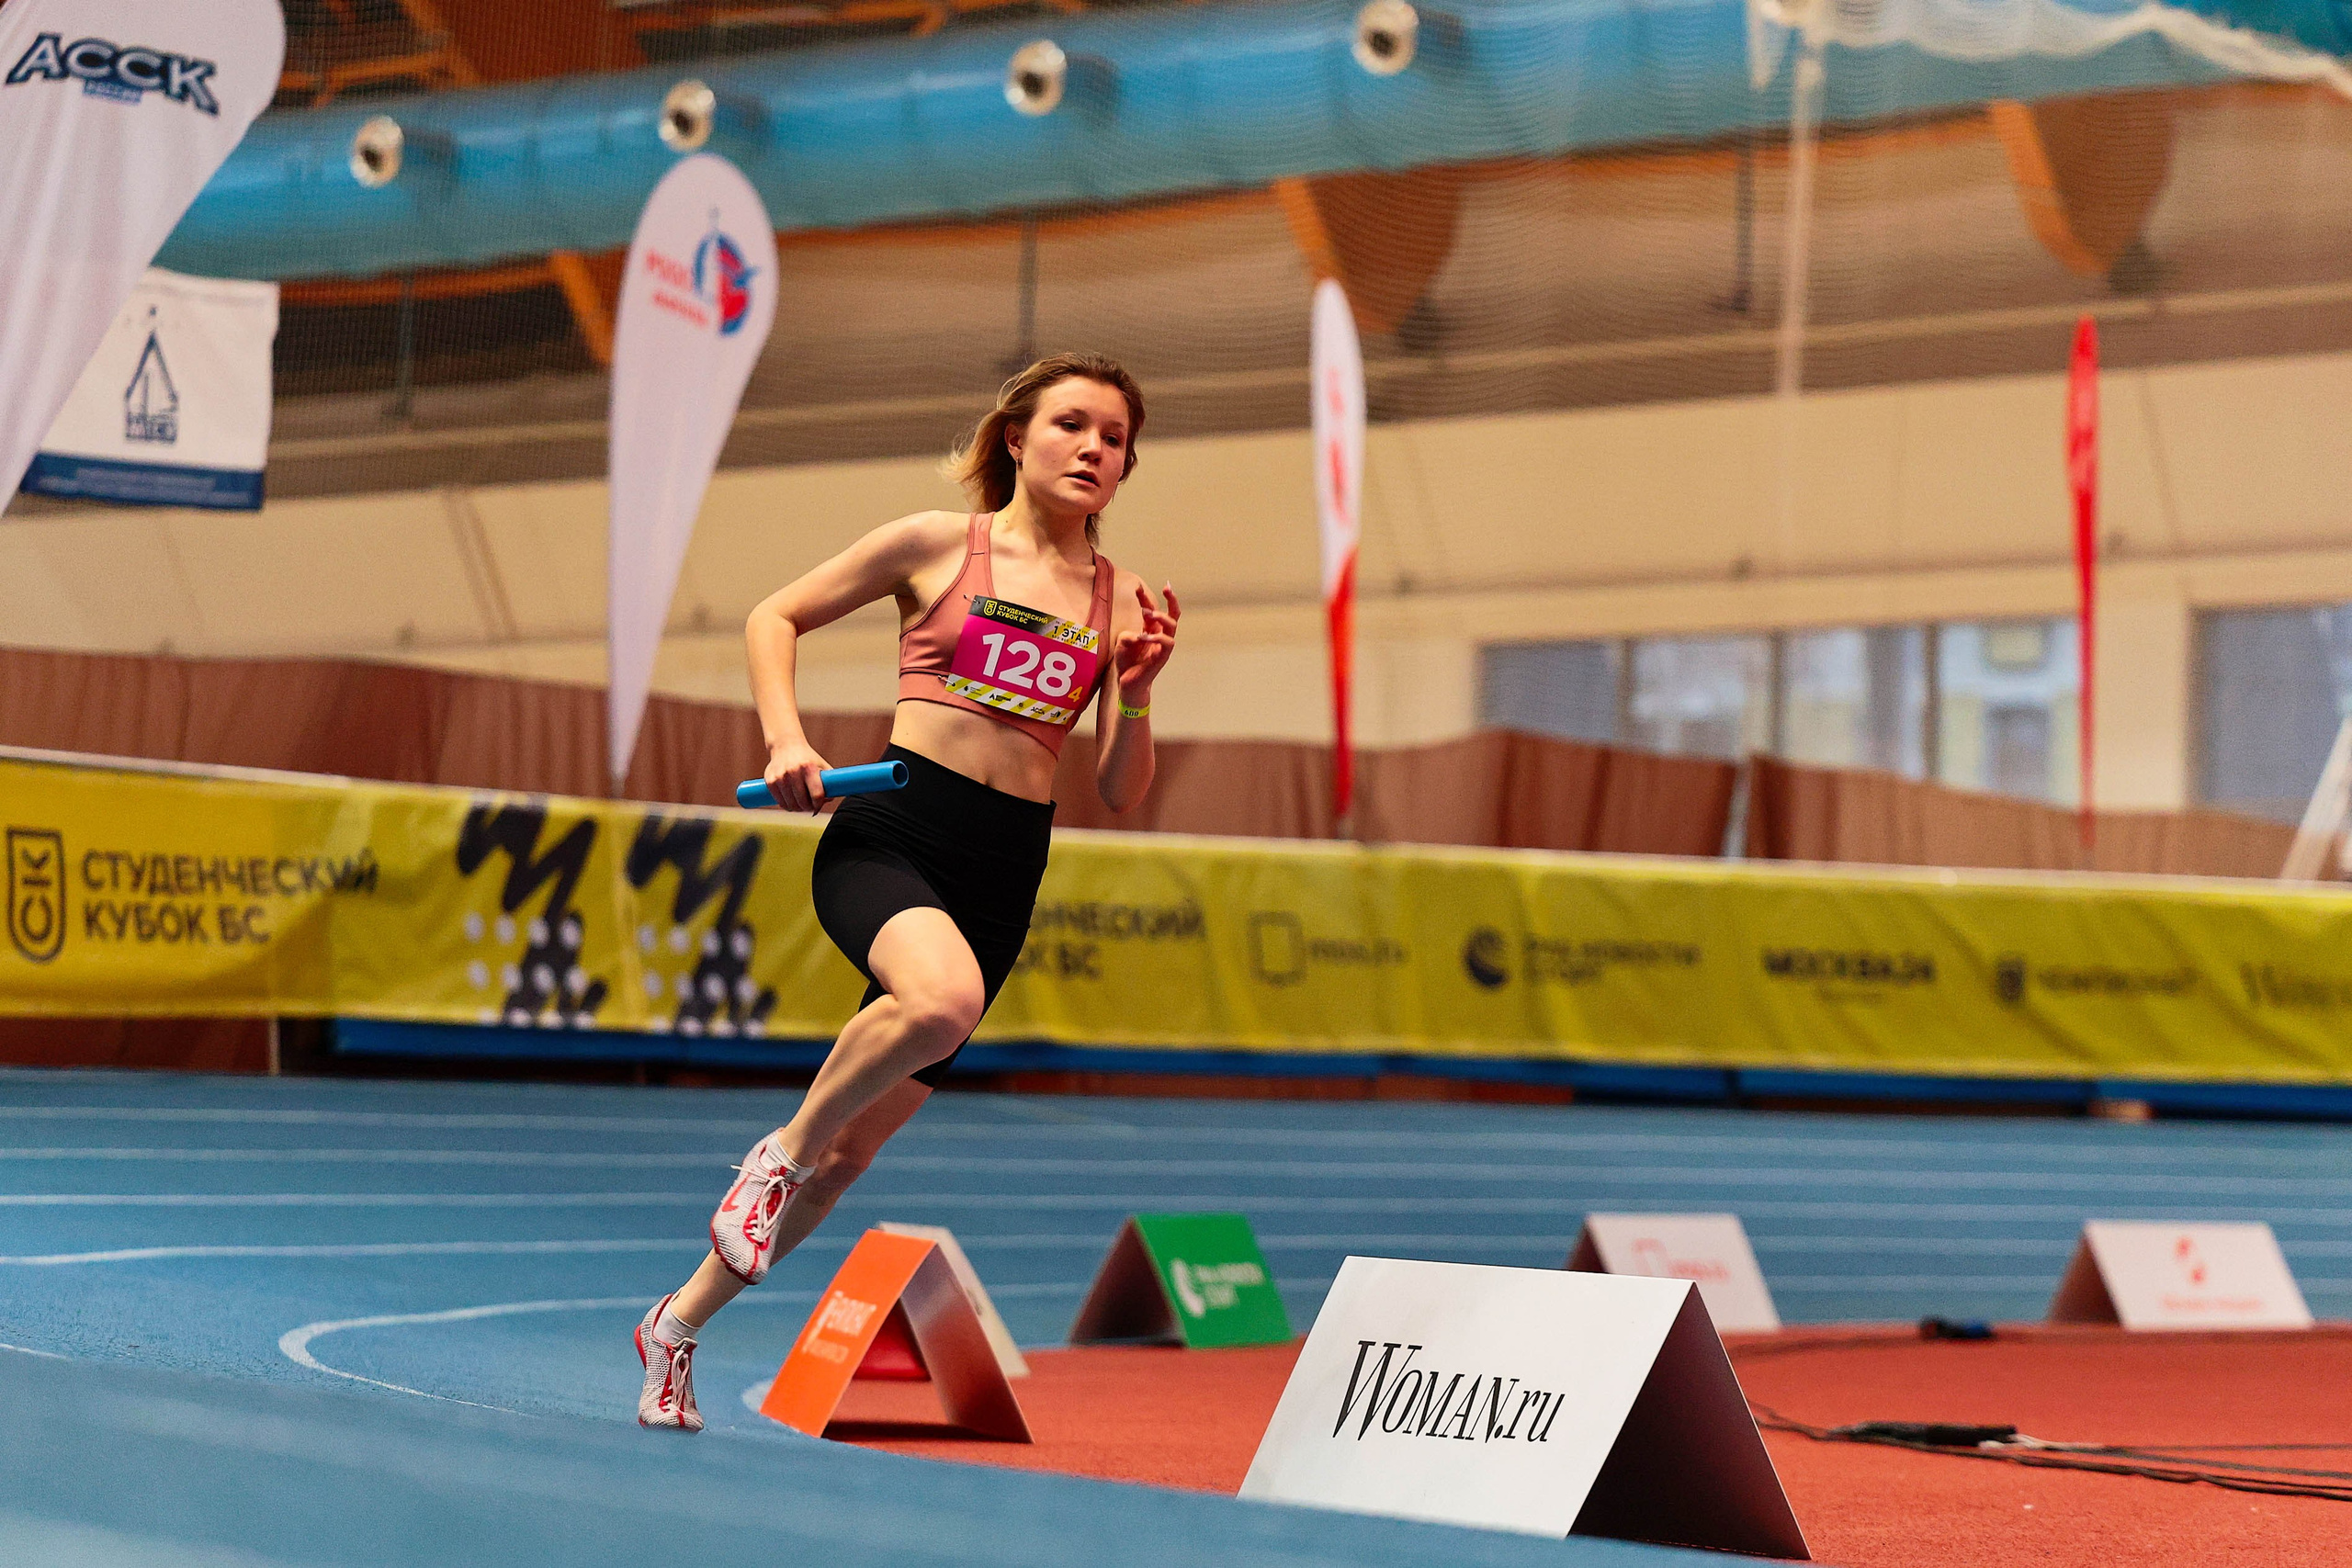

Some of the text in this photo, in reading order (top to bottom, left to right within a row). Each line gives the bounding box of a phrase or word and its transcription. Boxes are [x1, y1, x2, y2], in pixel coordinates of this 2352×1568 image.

[6, 31, 219, 115] АССК
[997, 610, 1018, 621] КУБОК
[999, 605, 1047, 624] СТУДЕНЧЕСКИЙ
[1054, 626, 1058, 634] 1
[1062, 628, 1090, 645] ЭТАП
[982, 633, 1076, 697] 128
[1068, 686, 1083, 703] 4
[81, 847, 379, 897] СТУДЕНЧЕСКИЙ
[84, 899, 271, 944] КУБОК БС
